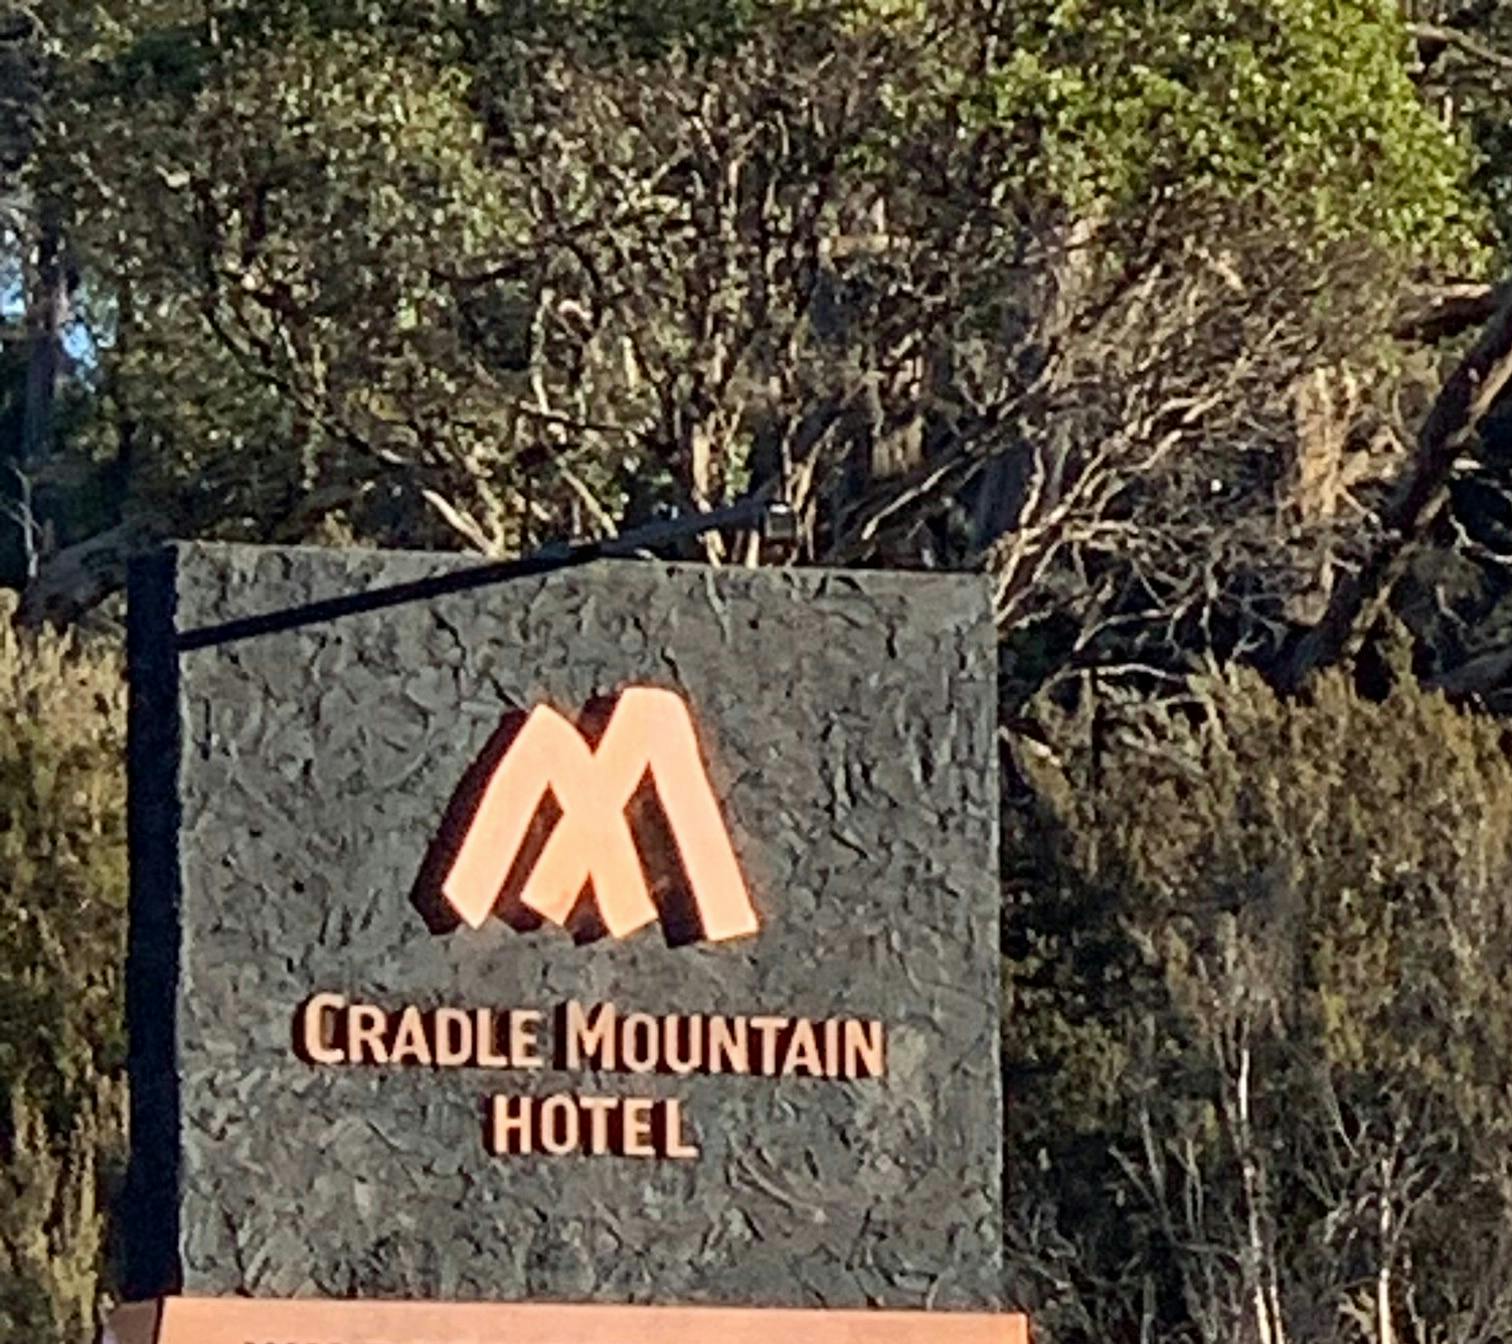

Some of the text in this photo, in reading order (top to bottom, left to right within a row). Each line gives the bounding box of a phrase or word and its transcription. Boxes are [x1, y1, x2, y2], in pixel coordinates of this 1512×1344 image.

[302, 992, 885, 1077] CRADLE MOUNTAIN
[491, 1094, 699, 1158] HOTEL
